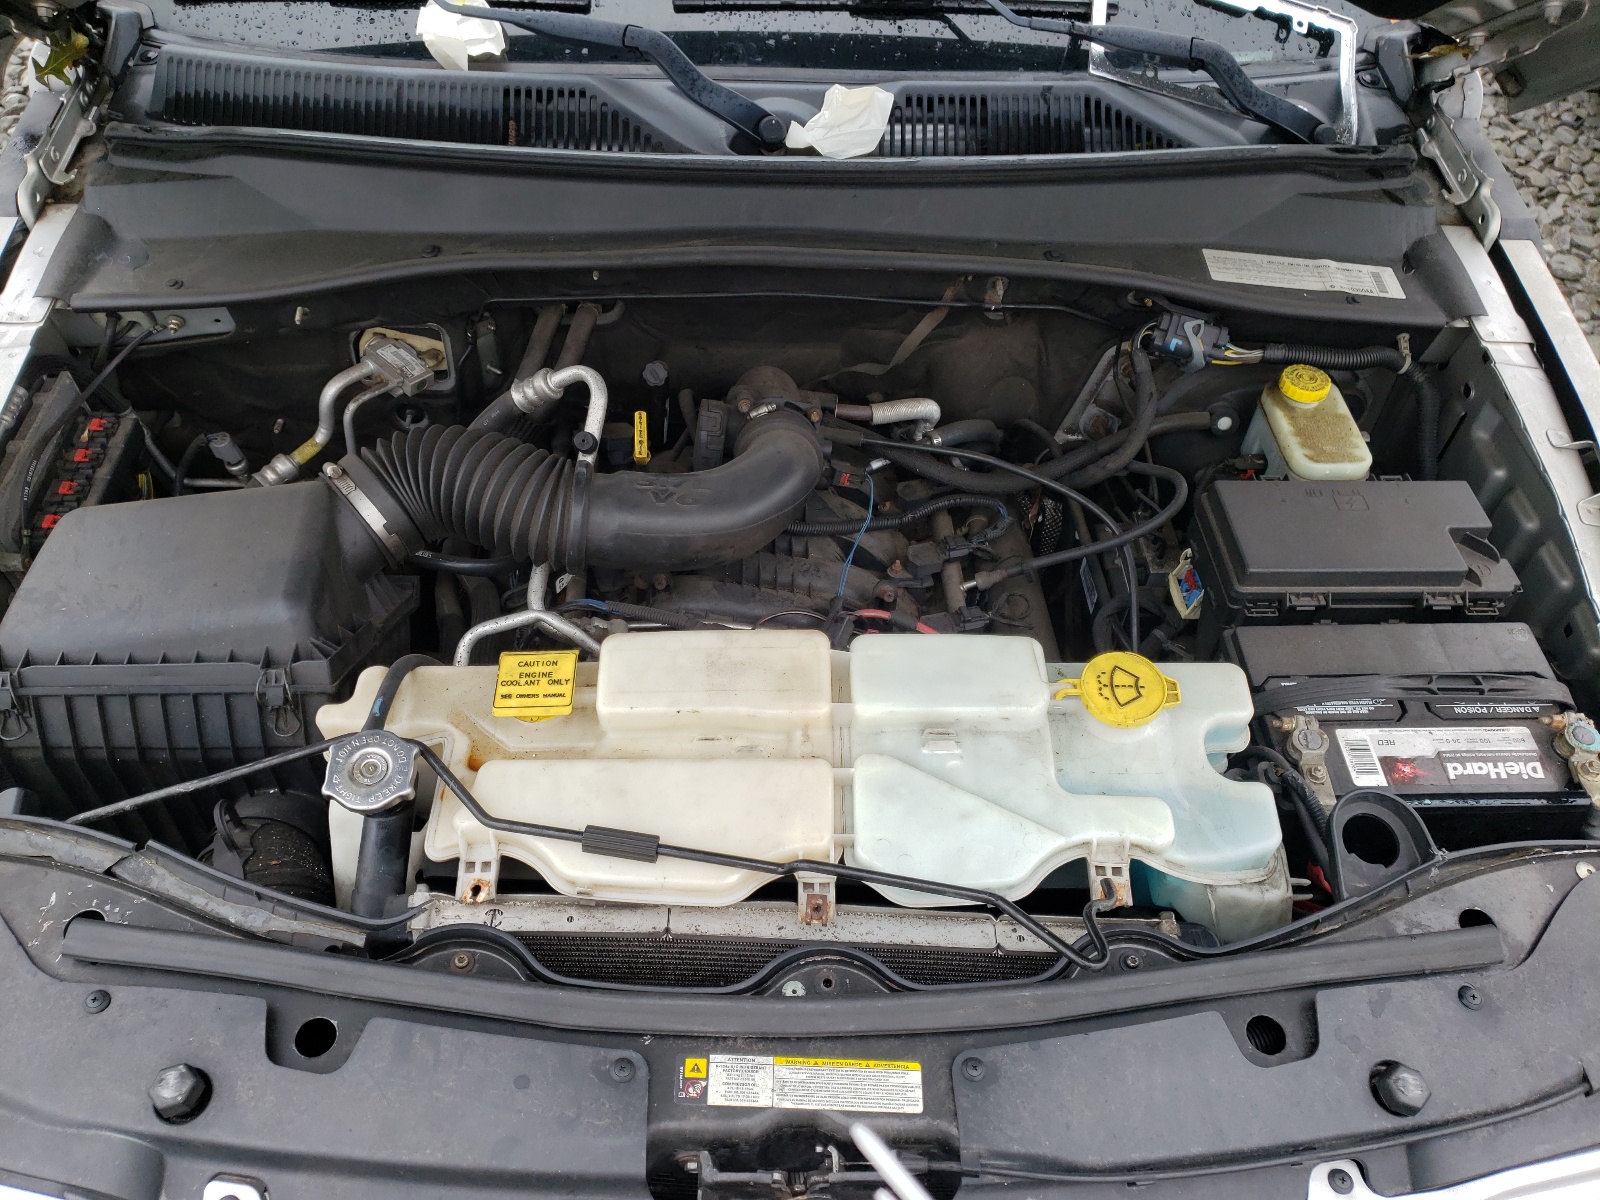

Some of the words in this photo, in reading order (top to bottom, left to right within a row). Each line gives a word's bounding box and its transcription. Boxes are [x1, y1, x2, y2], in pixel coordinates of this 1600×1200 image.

[517, 660, 559, 668] CAUTION
[518, 671, 554, 679] ENGINE
[500, 679, 541, 687] COOLANT
[547, 678, 571, 686] ONLY
[1453, 706, 1488, 714] POISON
[351, 735, 380, 747] OPEN
[382, 738, 400, 752] NOT
[1446, 761, 1546, 780] DieHard
[335, 785, 362, 804] TIGHT
[368, 785, 397, 803] KEEP
[785, 1058, 811, 1066] WARNING
